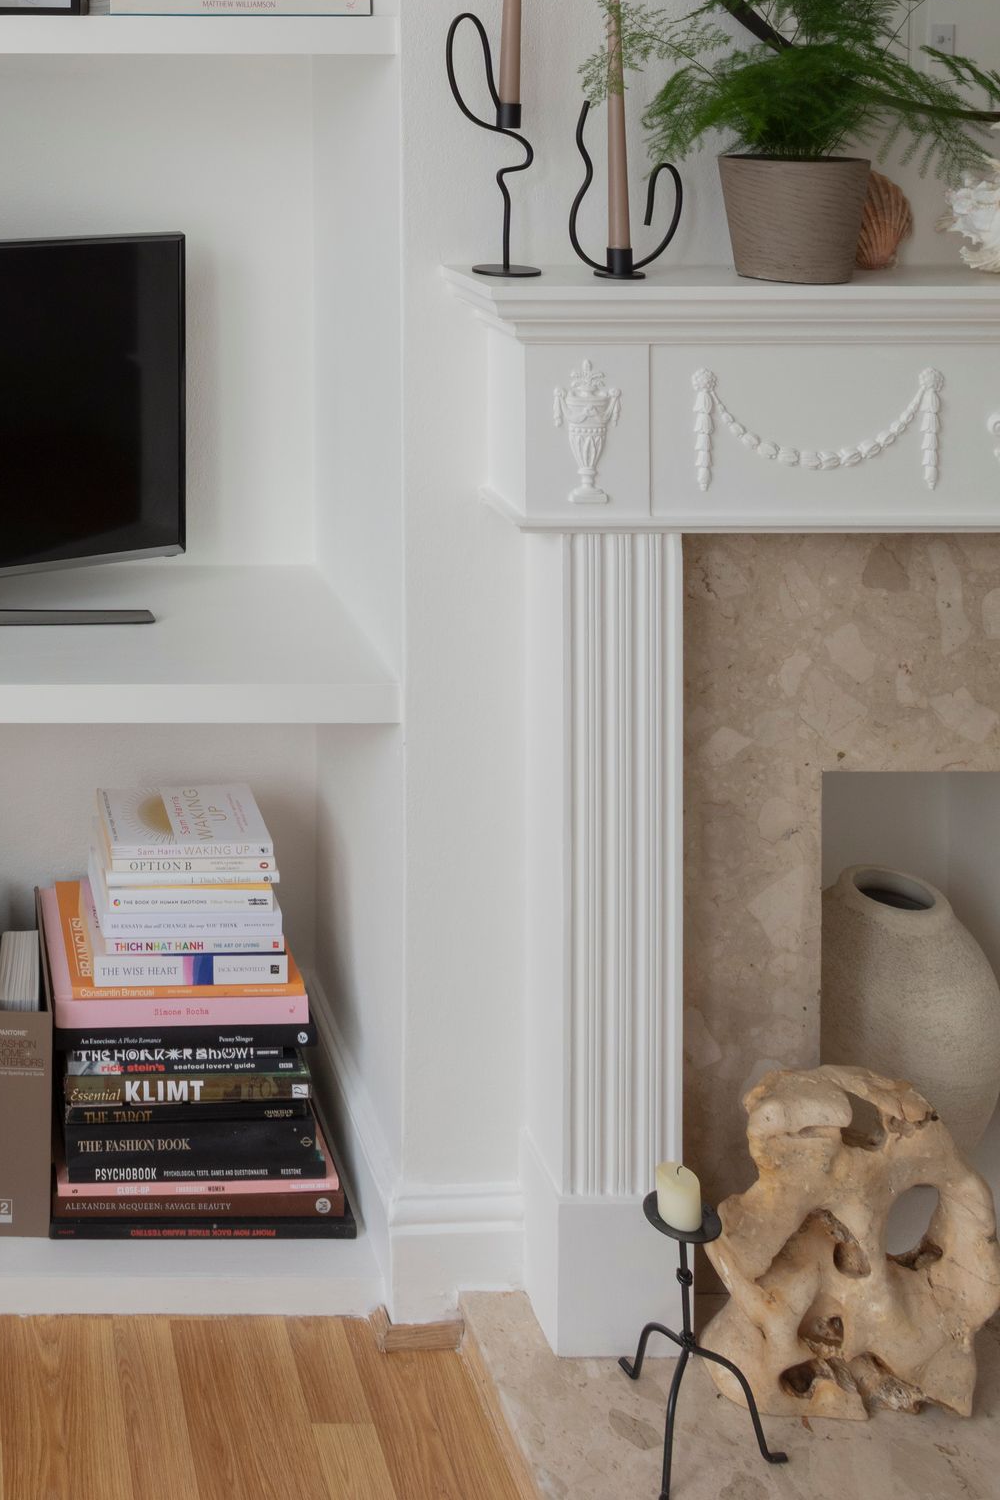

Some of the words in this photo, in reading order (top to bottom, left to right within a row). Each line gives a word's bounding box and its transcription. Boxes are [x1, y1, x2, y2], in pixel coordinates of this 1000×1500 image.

[202, 0, 233, 8] MATTHEW
[235, 0, 276, 8] WILLIAMSON
[172, 796, 183, 819] Harris
[183, 789, 214, 841] WAKING
[209, 806, 228, 823] UP
[180, 819, 191, 837] Sam
[137, 847, 155, 856] Sam
[157, 847, 182, 855] Harris
[183, 845, 231, 855] WAKING
[235, 845, 250, 855] UP
[130, 861, 180, 871] OPTION
[185, 861, 192, 871] B
[115, 942, 143, 952] THICH
[146, 941, 174, 951] NHAT
[175, 940, 204, 950] HANH
[102, 966, 120, 976] THE
[122, 966, 145, 976] WISE
[147, 966, 178, 976] HEART
[80, 988, 120, 998] Constantin
[121, 987, 155, 997] Brancusi
[235, 1035, 254, 1043] Slinger
[101, 1064, 124, 1072] rick
[127, 1063, 166, 1072] stein's
[206, 1062, 232, 1070] lovers'
[234, 1062, 256, 1070] guide
[70, 1088, 121, 1101] Essential
[125, 1080, 204, 1102] KLIMT
[84, 1111, 108, 1123] THE
[113, 1111, 153, 1122] TAROT
[78, 1140, 103, 1152] THE
[106, 1139, 156, 1151] FASHION
[157, 1138, 191, 1150] BOOK
[95, 1167, 157, 1180] PSYCHOBOOK
[117, 1186, 150, 1195] CLOSE-UP
[0, 1202, 9, 1214] 2
[65, 1202, 116, 1210] ALEXANDER
[165, 1202, 196, 1210] SAVAGE
[198, 1202, 231, 1211] BEAUTY
[162, 1229, 186, 1237] MARIO
[187, 1229, 211, 1237] STAGE
[212, 1229, 232, 1237] BACK
[233, 1229, 250, 1237] ROW
[251, 1229, 276, 1237] FRONT
